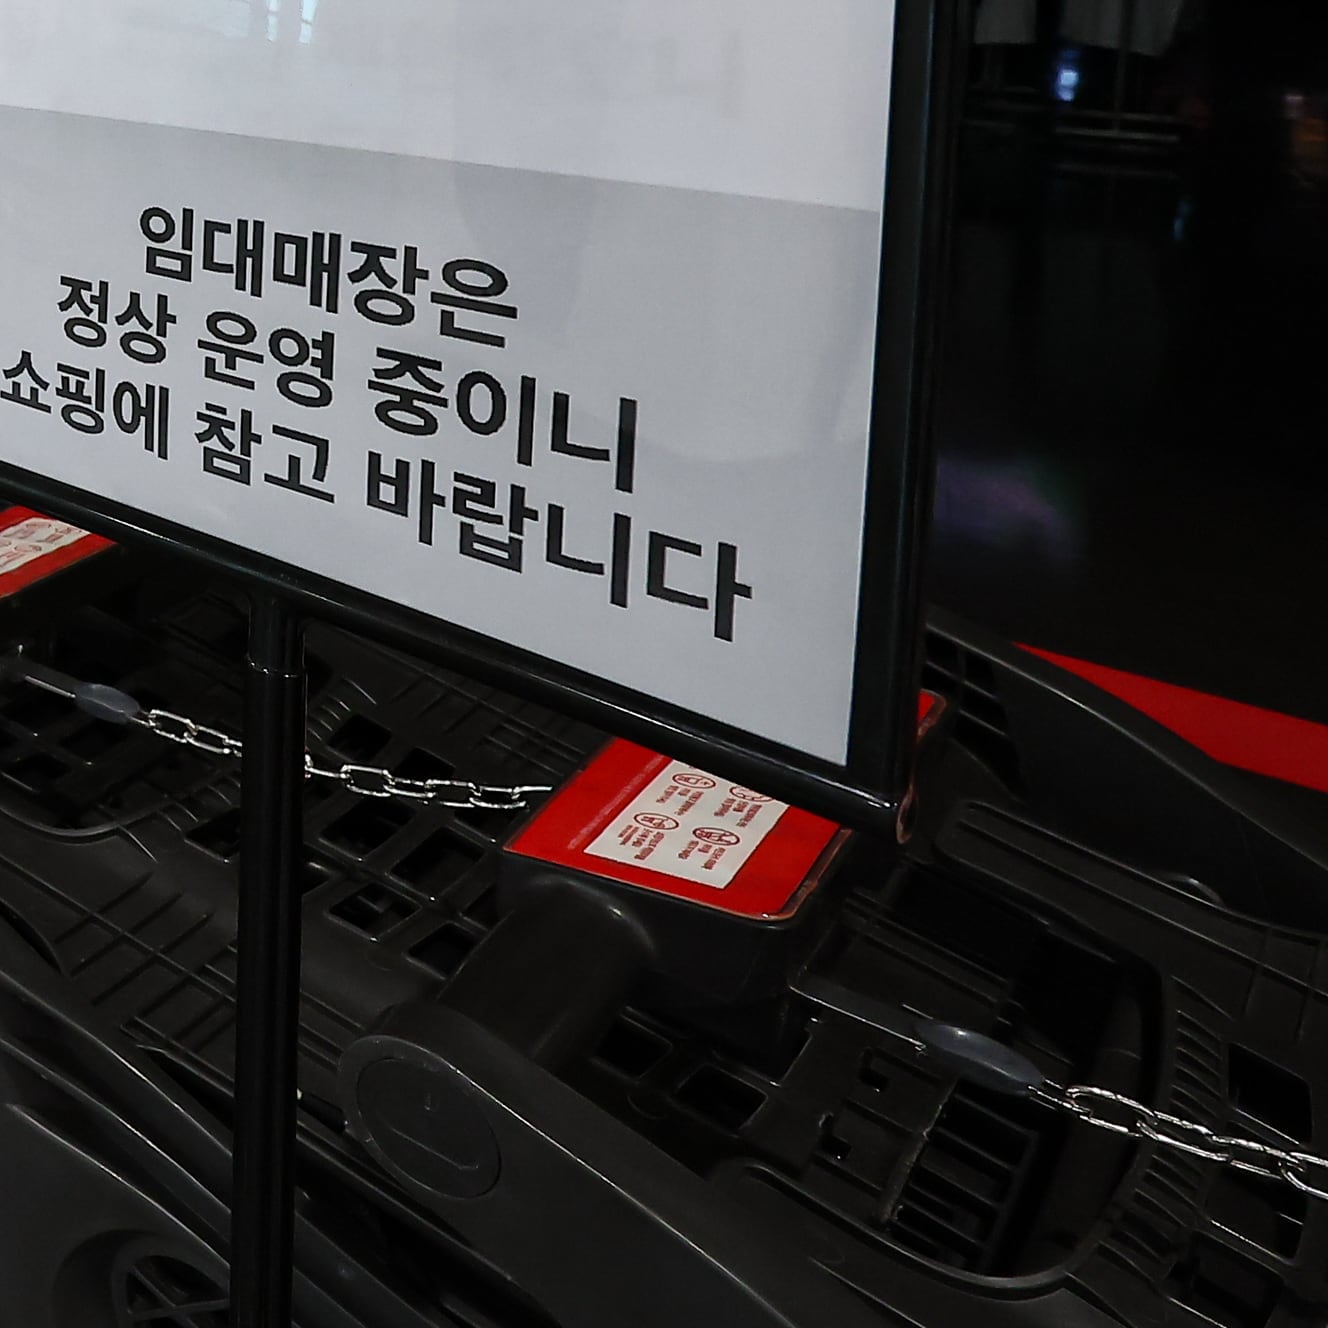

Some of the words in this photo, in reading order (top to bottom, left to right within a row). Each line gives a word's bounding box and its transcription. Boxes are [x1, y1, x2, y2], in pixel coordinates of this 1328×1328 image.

[55, 273, 178, 366] 정상
[195, 308, 337, 409] 운영
[365, 344, 640, 494] 중이니
[137, 204, 519, 350] 임대매장은
[194, 402, 339, 506] 참고
[365, 451, 754, 644] 바랍니다
